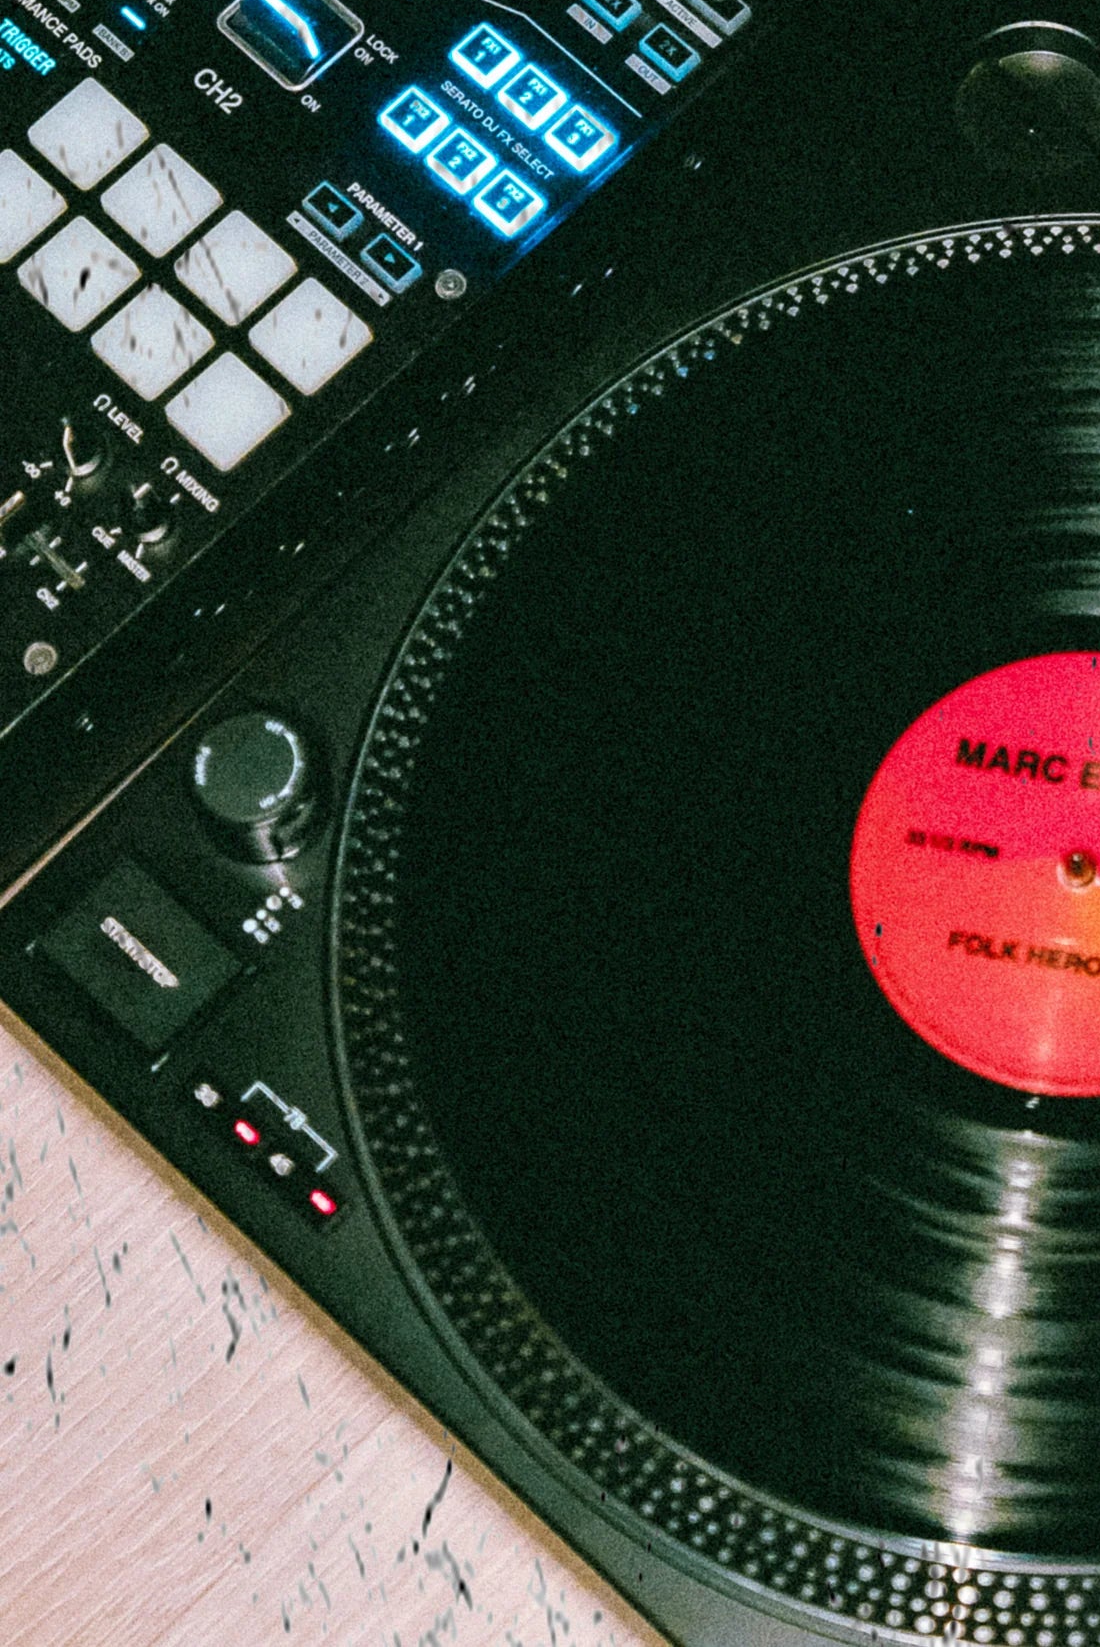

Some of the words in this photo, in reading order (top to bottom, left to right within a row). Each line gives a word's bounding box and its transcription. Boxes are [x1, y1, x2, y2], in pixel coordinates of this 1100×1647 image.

[153, 2, 171, 19] ON
[665, 0, 697, 27] ACTIVE
[0, 17, 57, 77] TRIGGER
[62, 32, 103, 69] PADS
[352, 46, 375, 66] ON
[365, 33, 400, 66] LOCK
[193, 67, 244, 115] CH2
[526, 76, 548, 96] FX1
[637, 65, 659, 85] OUT
[299, 93, 322, 114] ON
[518, 90, 534, 105] 2
[440, 80, 486, 122] SERATO
[481, 115, 501, 135] DJ
[496, 129, 516, 149] FX
[510, 141, 556, 181] SELECT
[447, 155, 463, 170] 2
[346, 181, 418, 246] PARAMETER
[412, 239, 425, 252] 1
[307, 230, 363, 283] PARAMETER
[107, 406, 145, 445] LEVEL
[175, 468, 221, 514] MIXING
[956, 738, 1069, 784] MARC
